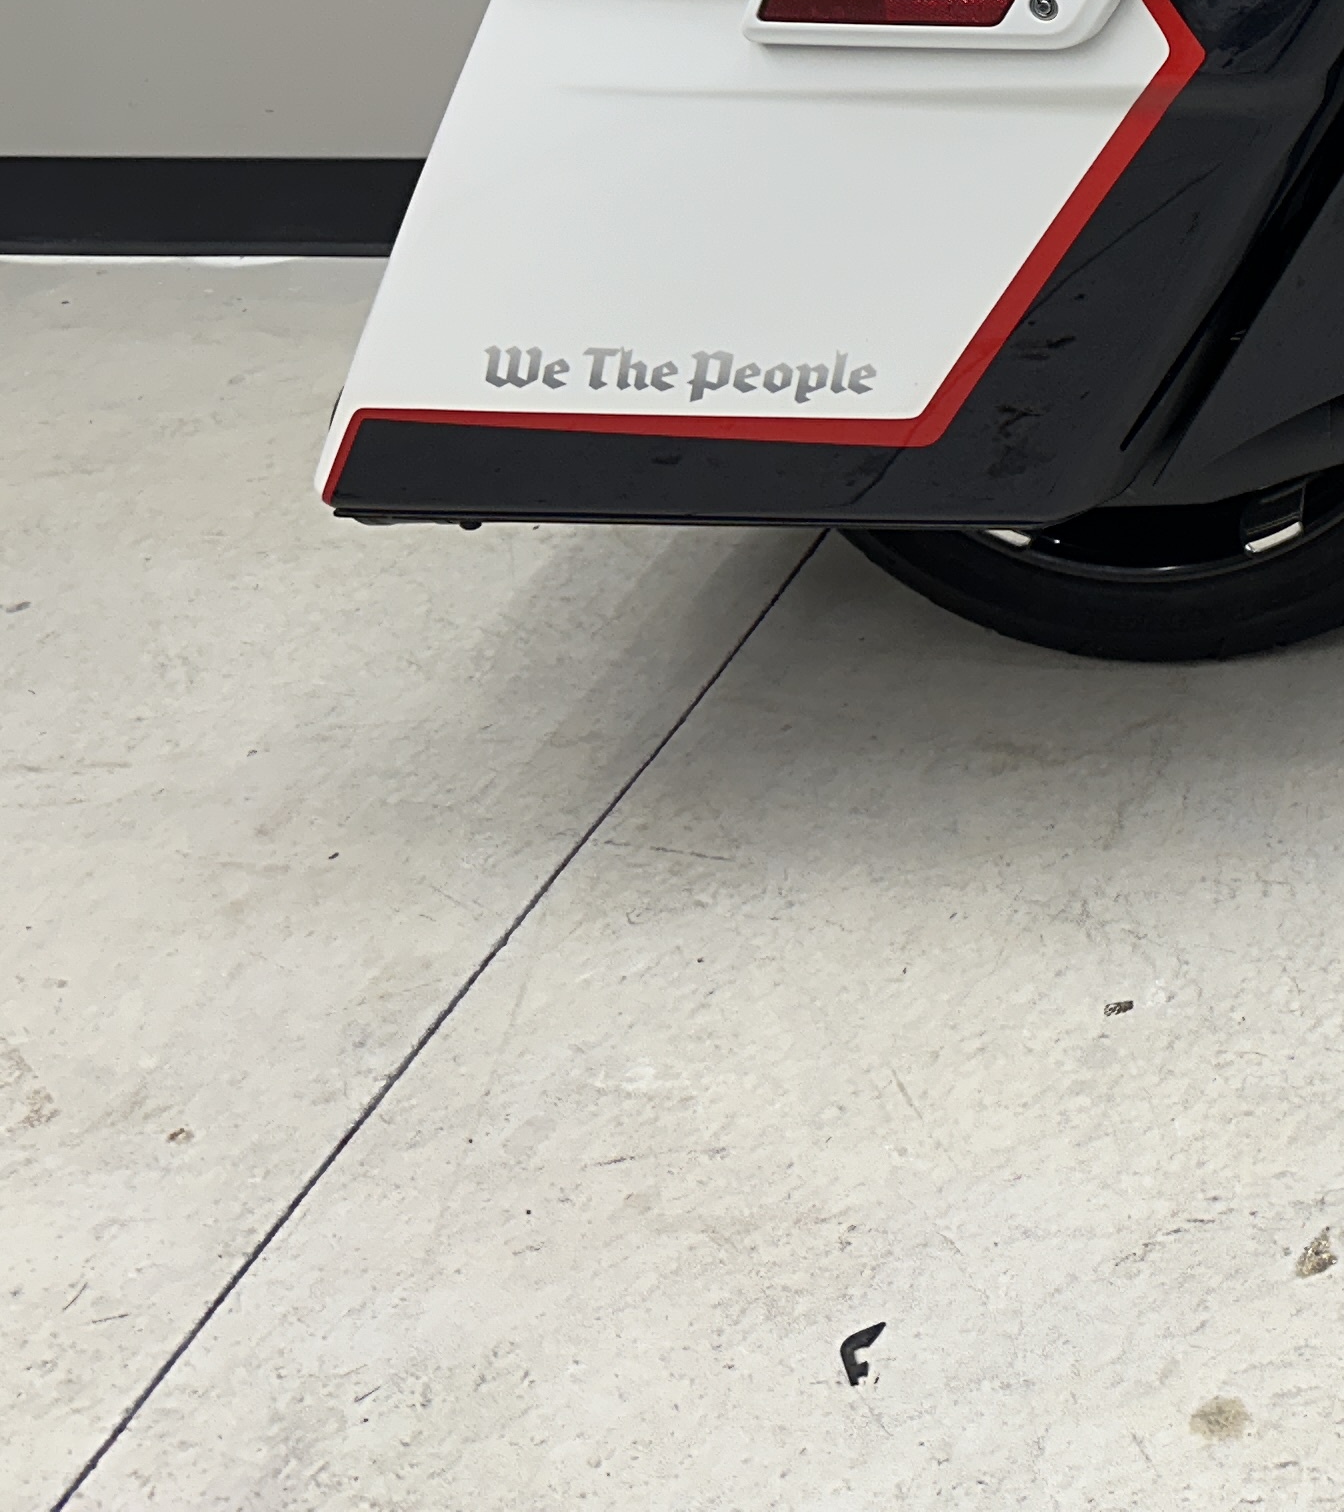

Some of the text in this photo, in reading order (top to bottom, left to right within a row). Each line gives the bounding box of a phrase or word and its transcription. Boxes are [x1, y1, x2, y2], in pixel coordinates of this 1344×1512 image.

[484, 345, 877, 404] We The People
